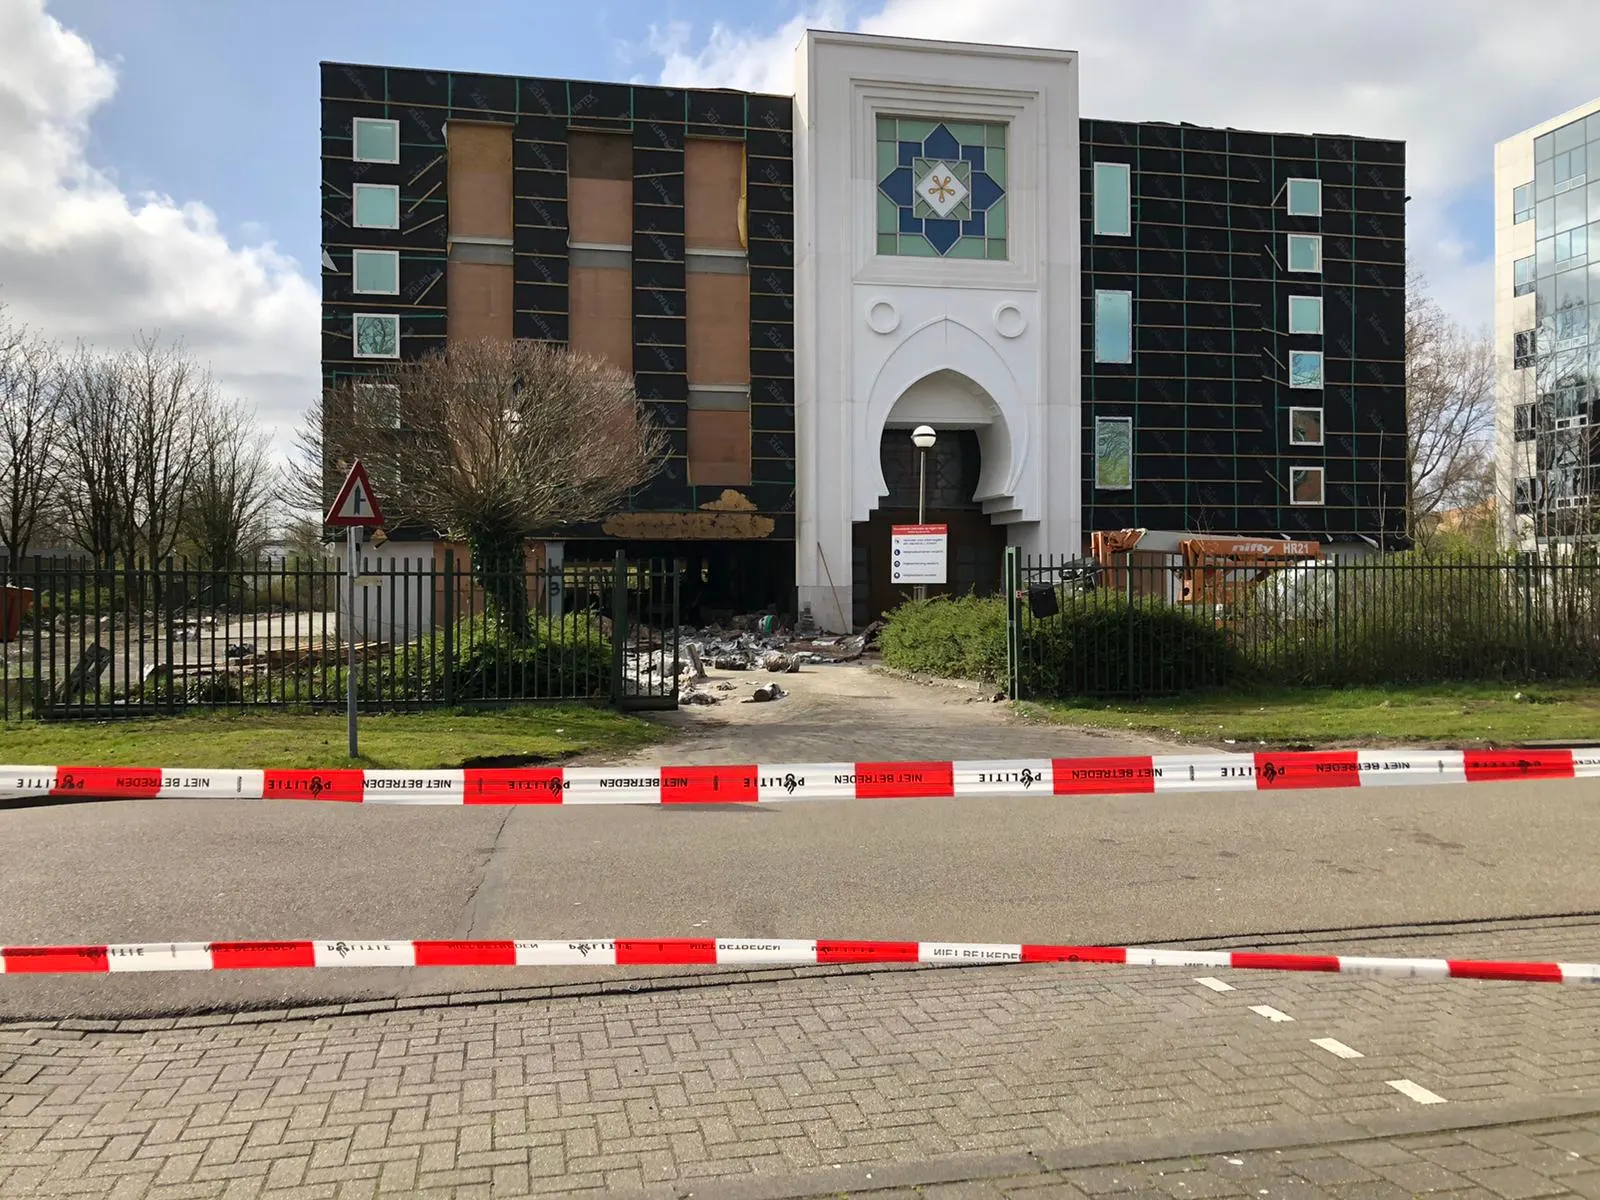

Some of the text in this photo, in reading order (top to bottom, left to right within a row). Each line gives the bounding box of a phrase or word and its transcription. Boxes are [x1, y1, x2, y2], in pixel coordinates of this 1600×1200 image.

[1232, 543, 1309, 554] nifty HR21
[1315, 761, 1411, 772] NIET BETREDEN
[834, 773, 923, 784] NIET BETREDEN
[1072, 768, 1163, 780] NIET BETREDEN
[116, 778, 210, 788] NIET BETREDEN
[362, 779, 452, 789] NIET BETREDEN
[600, 778, 688, 788] NIET BETREDEN
